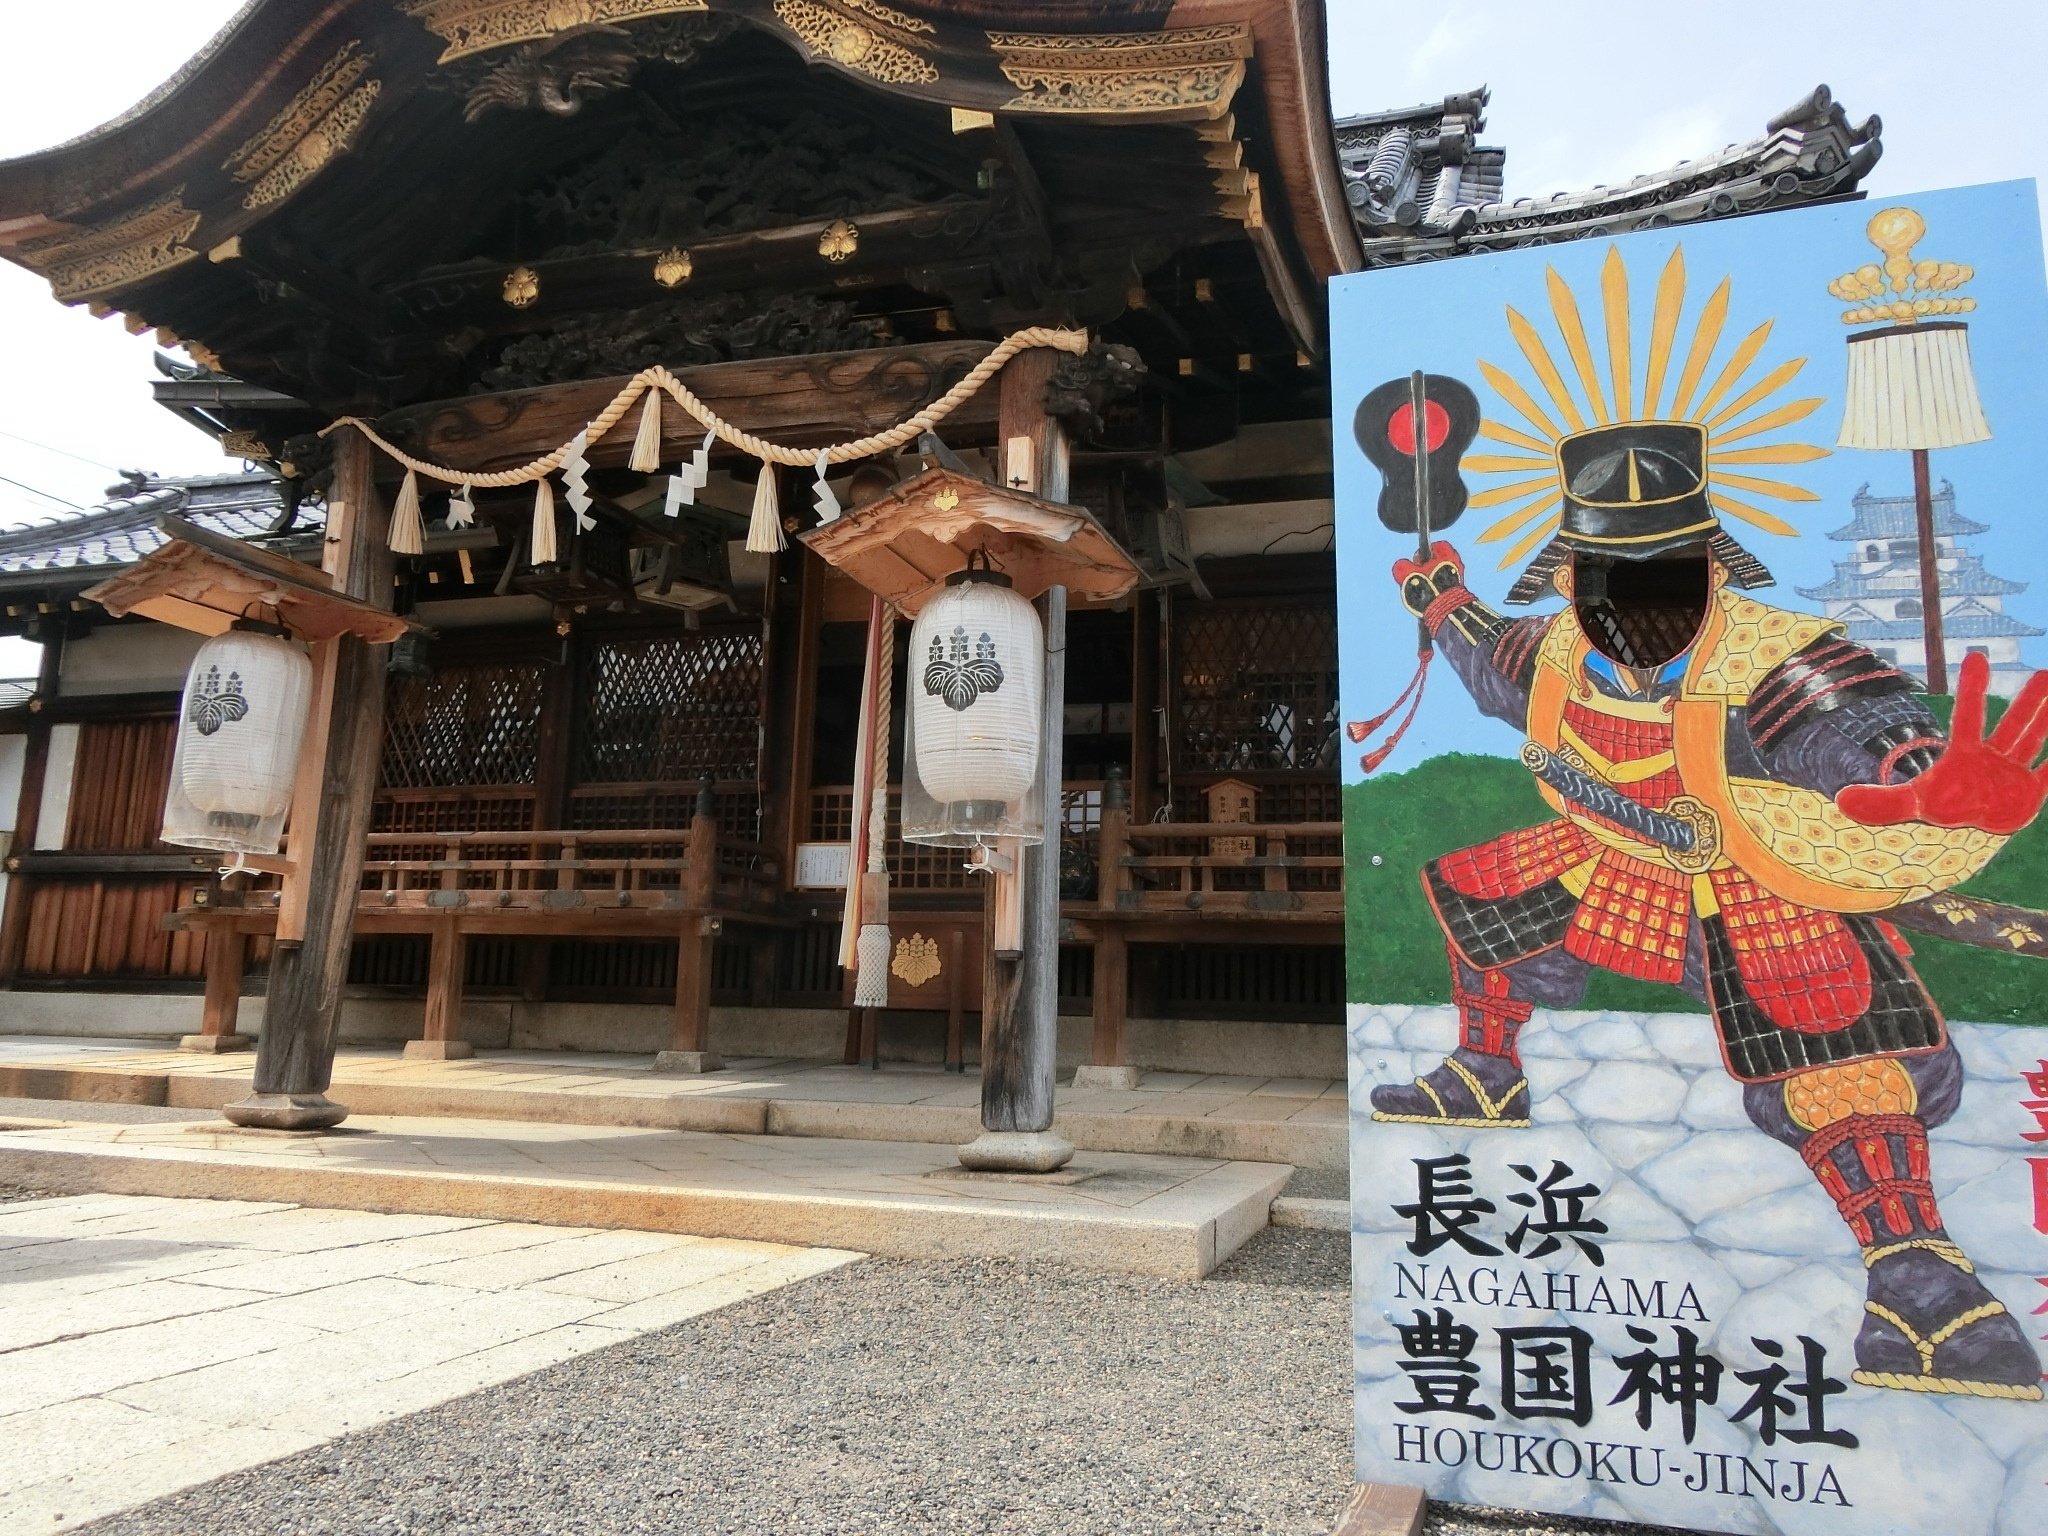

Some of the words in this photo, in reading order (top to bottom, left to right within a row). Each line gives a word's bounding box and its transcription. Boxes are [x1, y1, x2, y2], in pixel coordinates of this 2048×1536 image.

[1390, 1153, 1609, 1267] 長浜
[1393, 1262, 1710, 1322] NAGAHAMA
[1391, 1307, 1860, 1450] 豊国神社
[1393, 1423, 1854, 1508] HOUKOKU-JINJA
